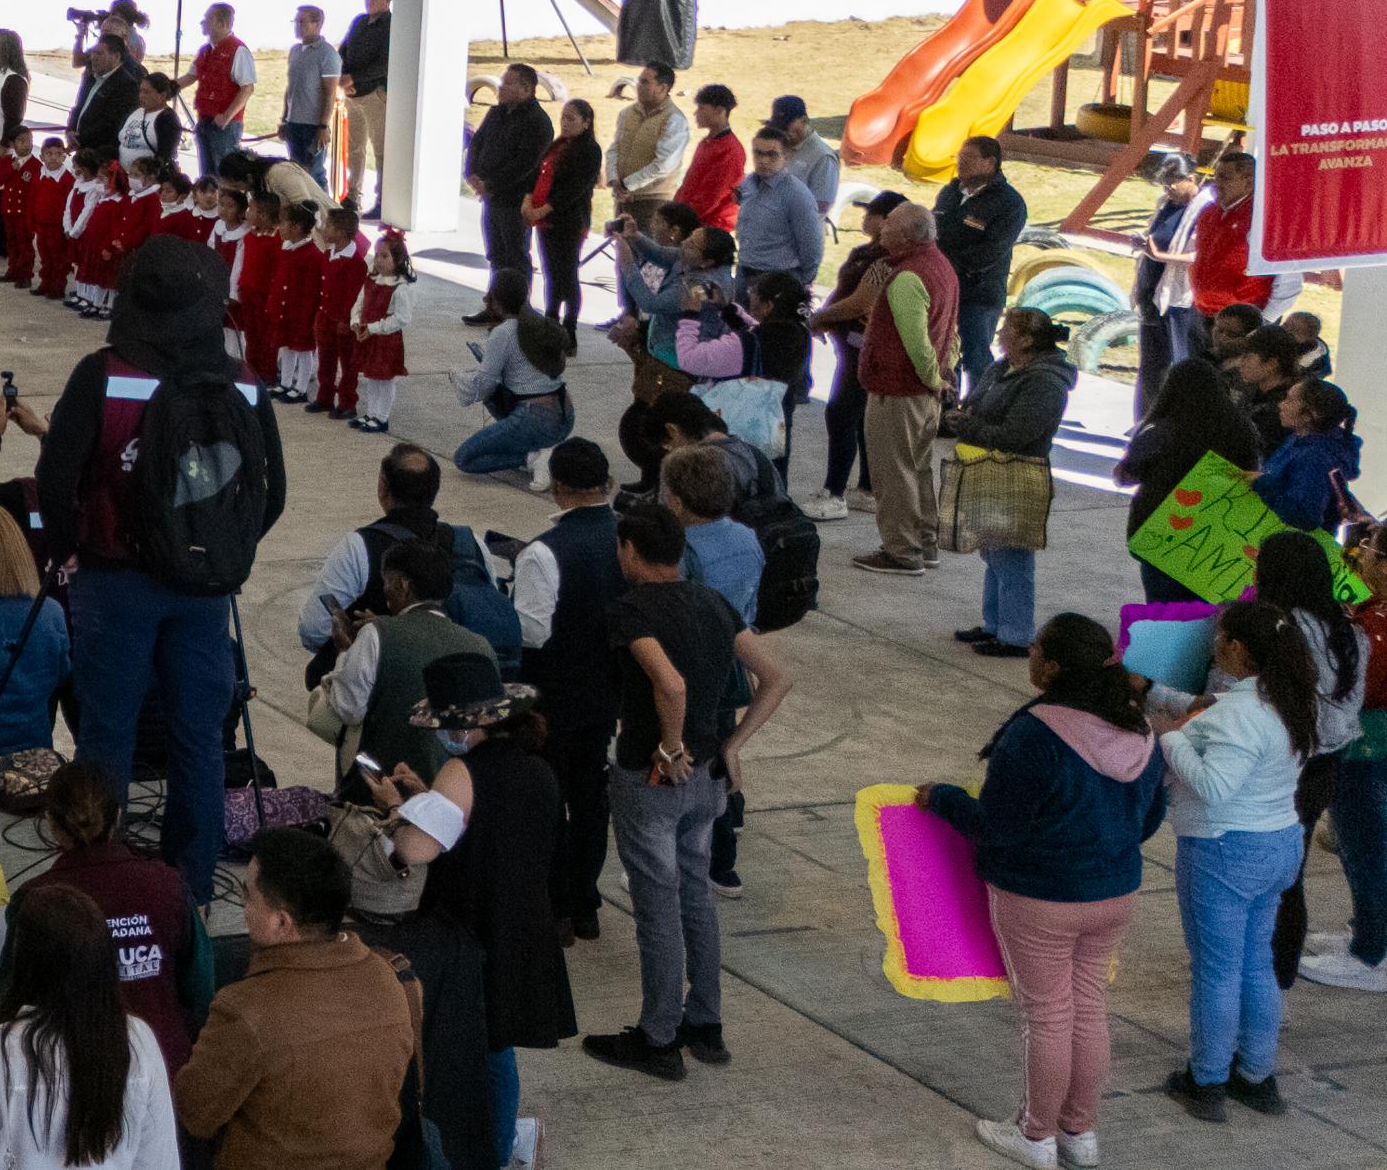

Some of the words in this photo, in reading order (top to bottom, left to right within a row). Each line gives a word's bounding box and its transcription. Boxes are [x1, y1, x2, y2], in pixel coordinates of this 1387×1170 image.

[1300, 122, 1339, 136] PASO
[1340, 121, 1351, 134] A
[1352, 118, 1387, 133] PASO
[1270, 144, 1289, 156] LA
[1290, 137, 1387, 155] TRANSFORMA
[1318, 155, 1373, 170] AVANZA
[106, 913, 147, 928] ENCIÓN
[112, 926, 152, 938] ADANA
[118, 944, 163, 965] UCA
[124, 961, 158, 975] ITAL
